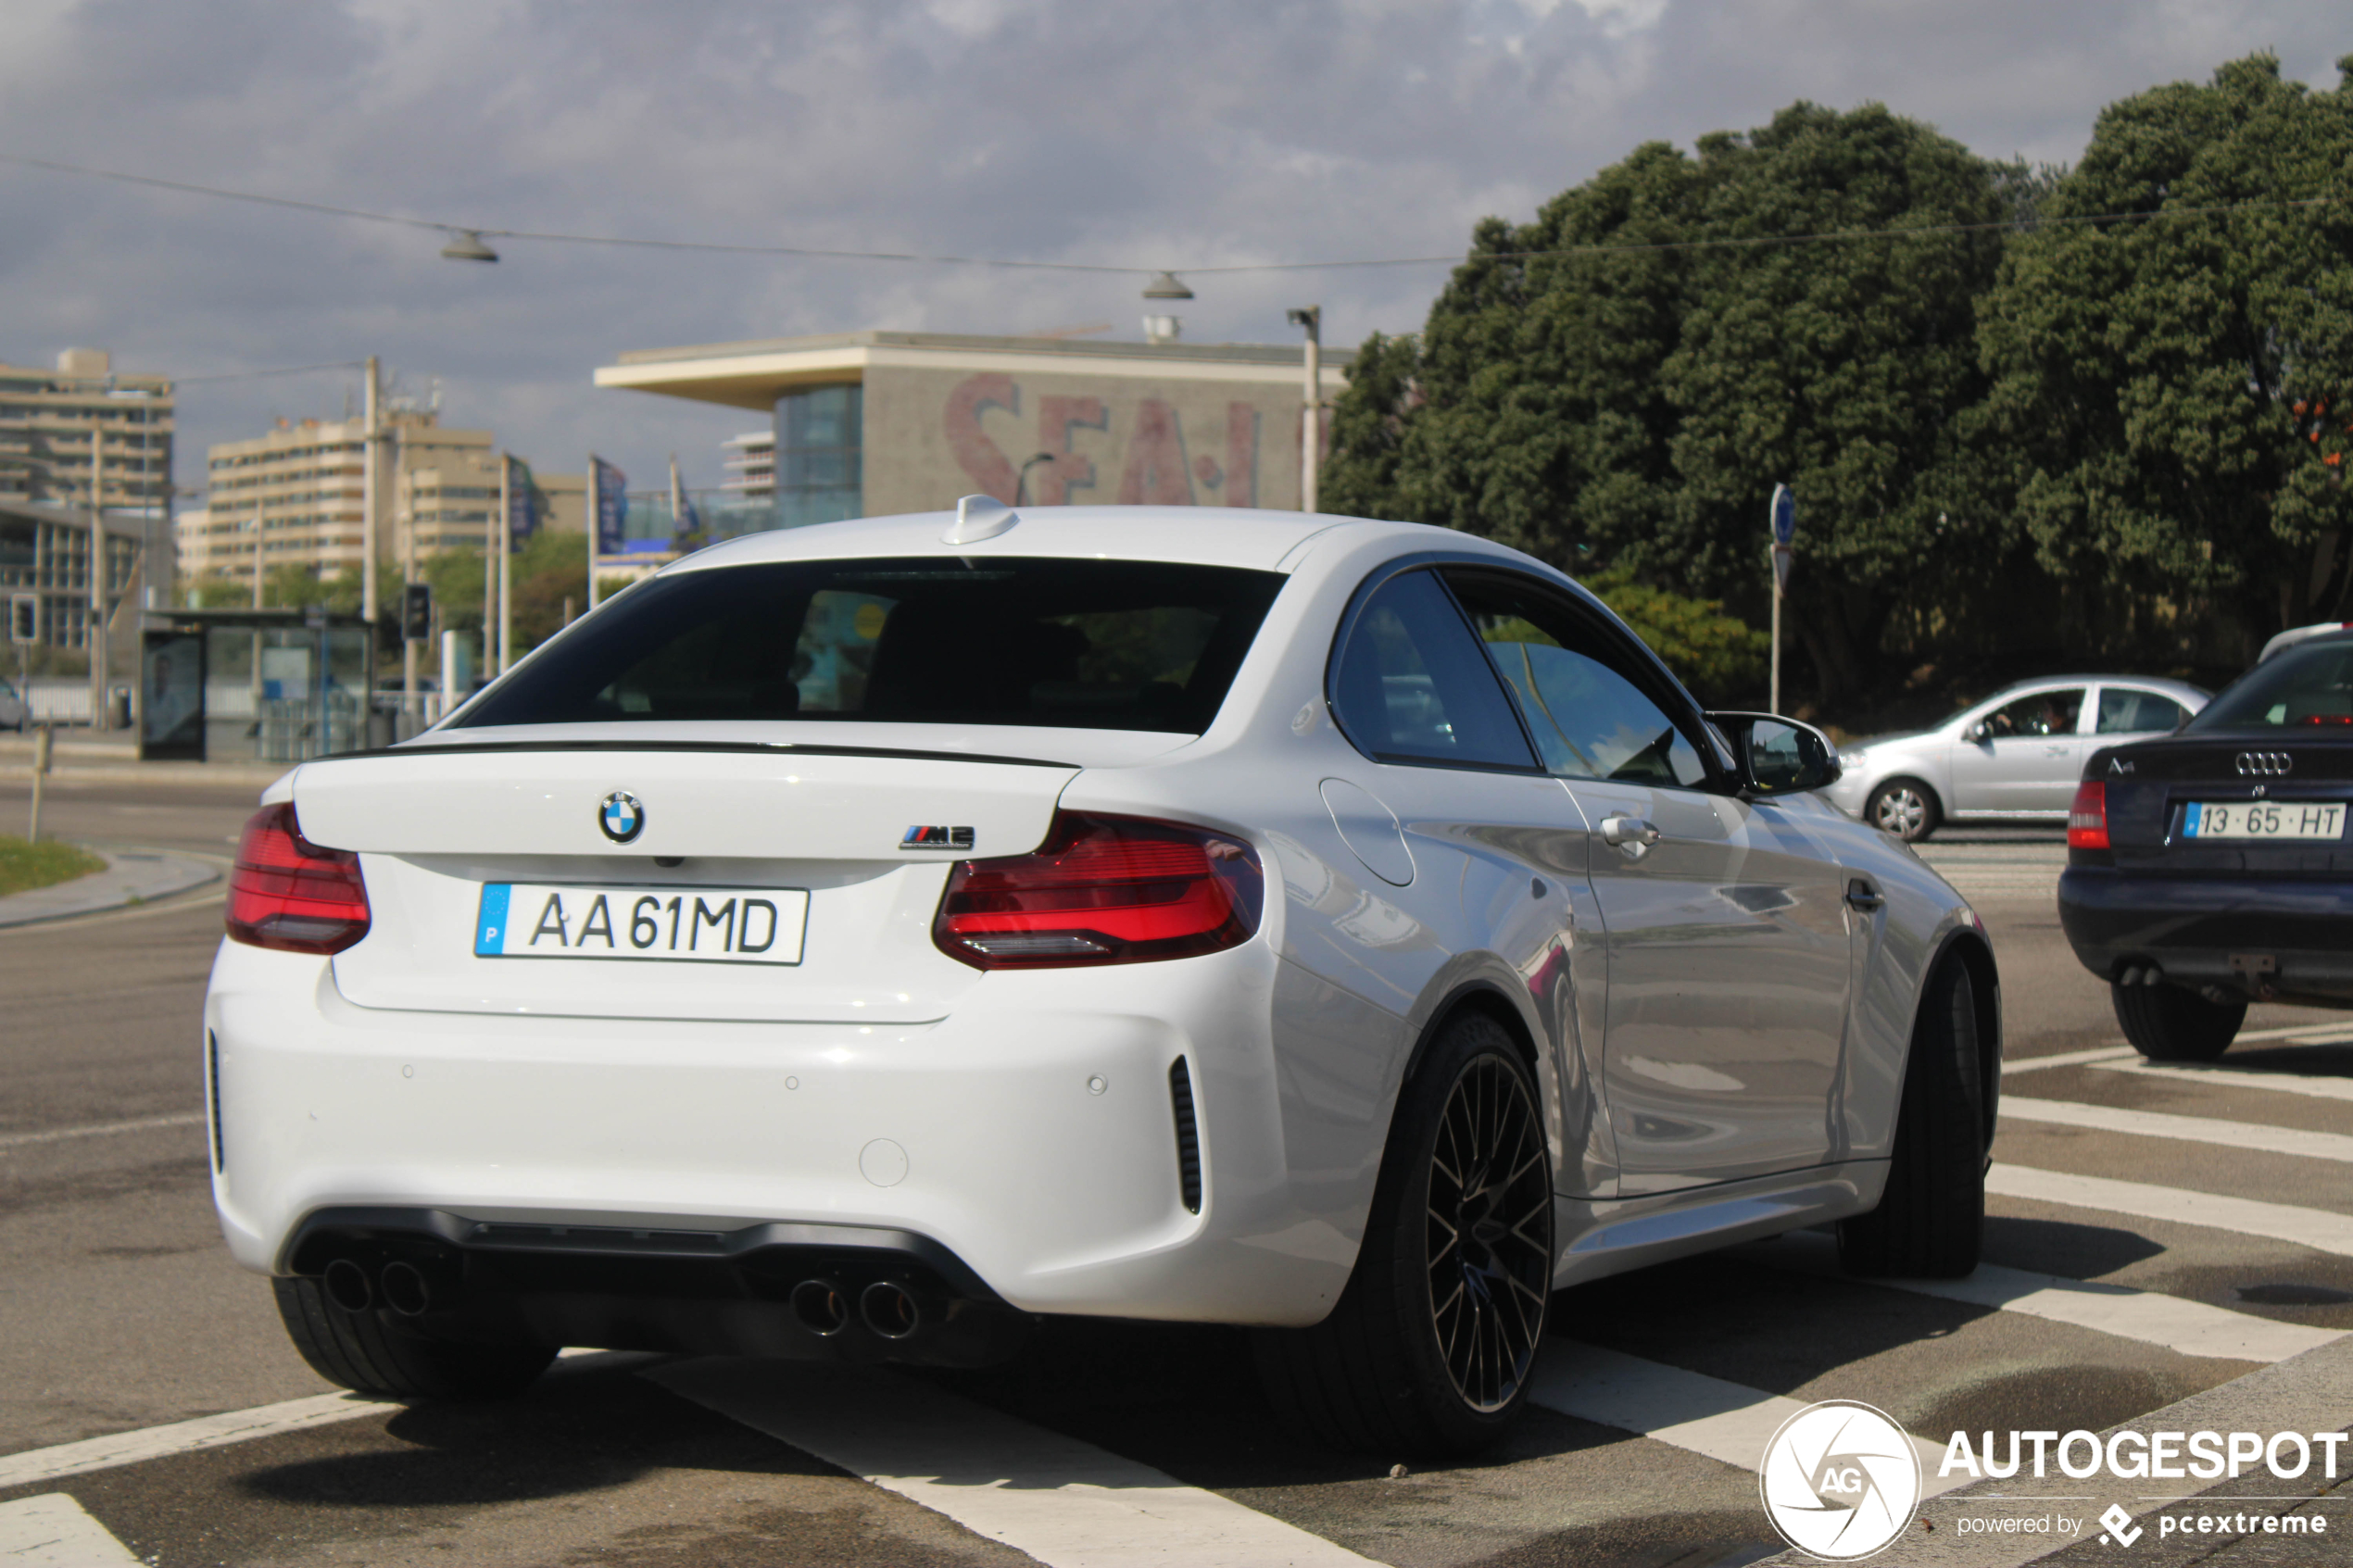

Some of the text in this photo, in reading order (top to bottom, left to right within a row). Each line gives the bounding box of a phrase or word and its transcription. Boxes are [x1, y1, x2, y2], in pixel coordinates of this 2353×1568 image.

[2108, 757, 2135, 774] A4
[602, 792, 640, 809] BMW
[484, 927, 497, 943] P
